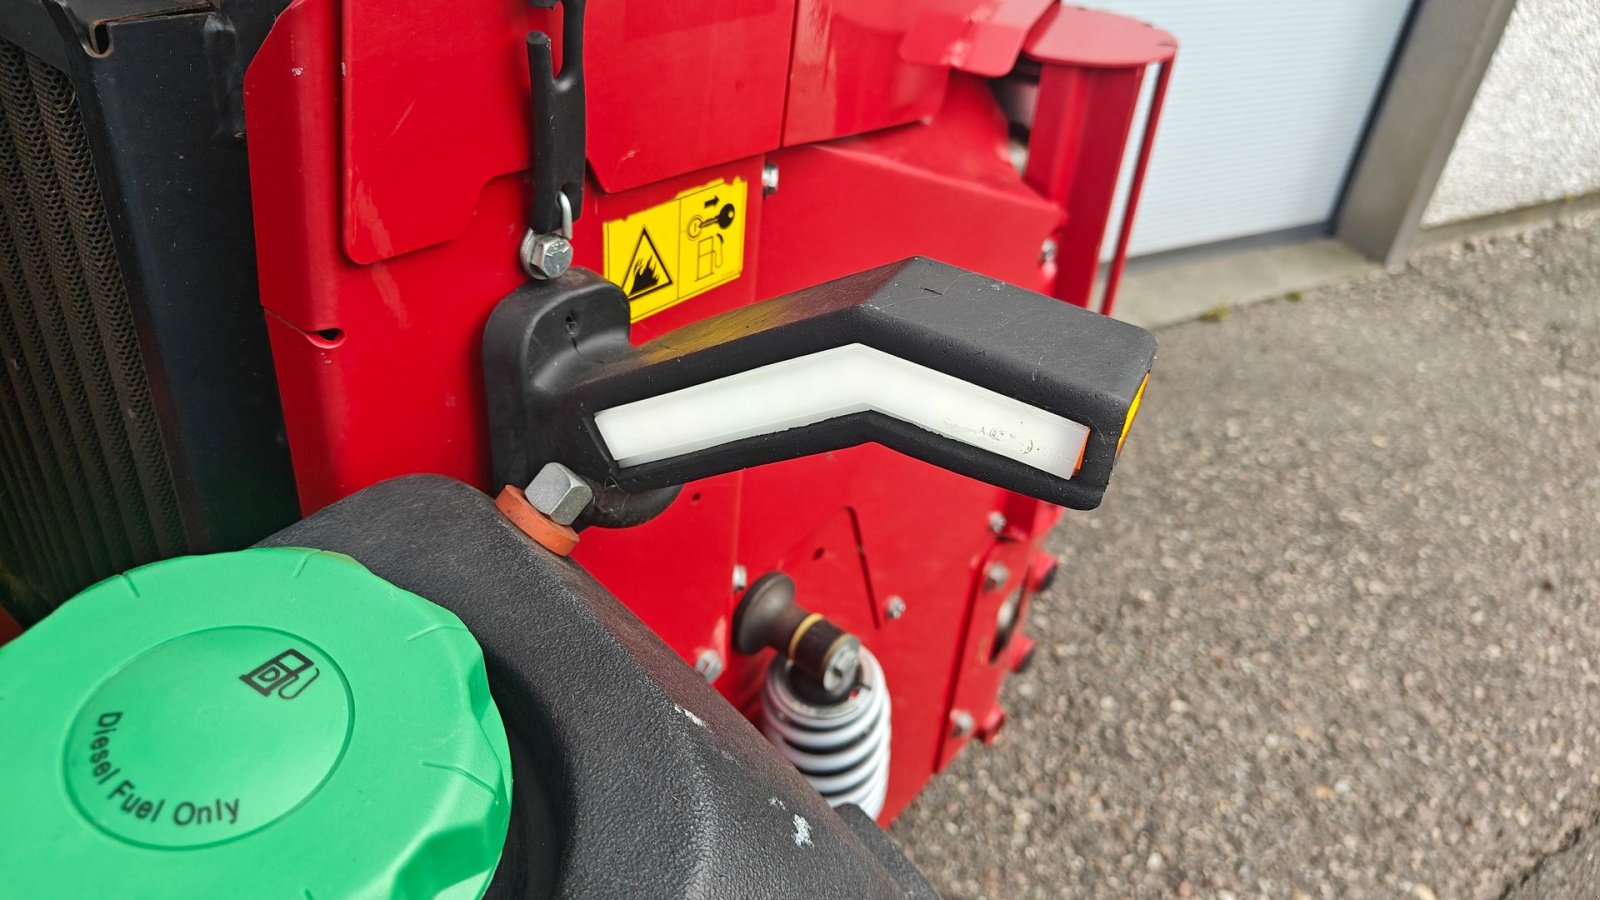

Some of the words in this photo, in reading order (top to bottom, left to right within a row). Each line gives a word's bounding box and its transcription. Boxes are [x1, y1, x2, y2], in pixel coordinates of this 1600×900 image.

[257, 666, 280, 682] D
[90, 711, 122, 785] Diesel
[107, 780, 165, 823] Fuel
[173, 798, 239, 826] Only
